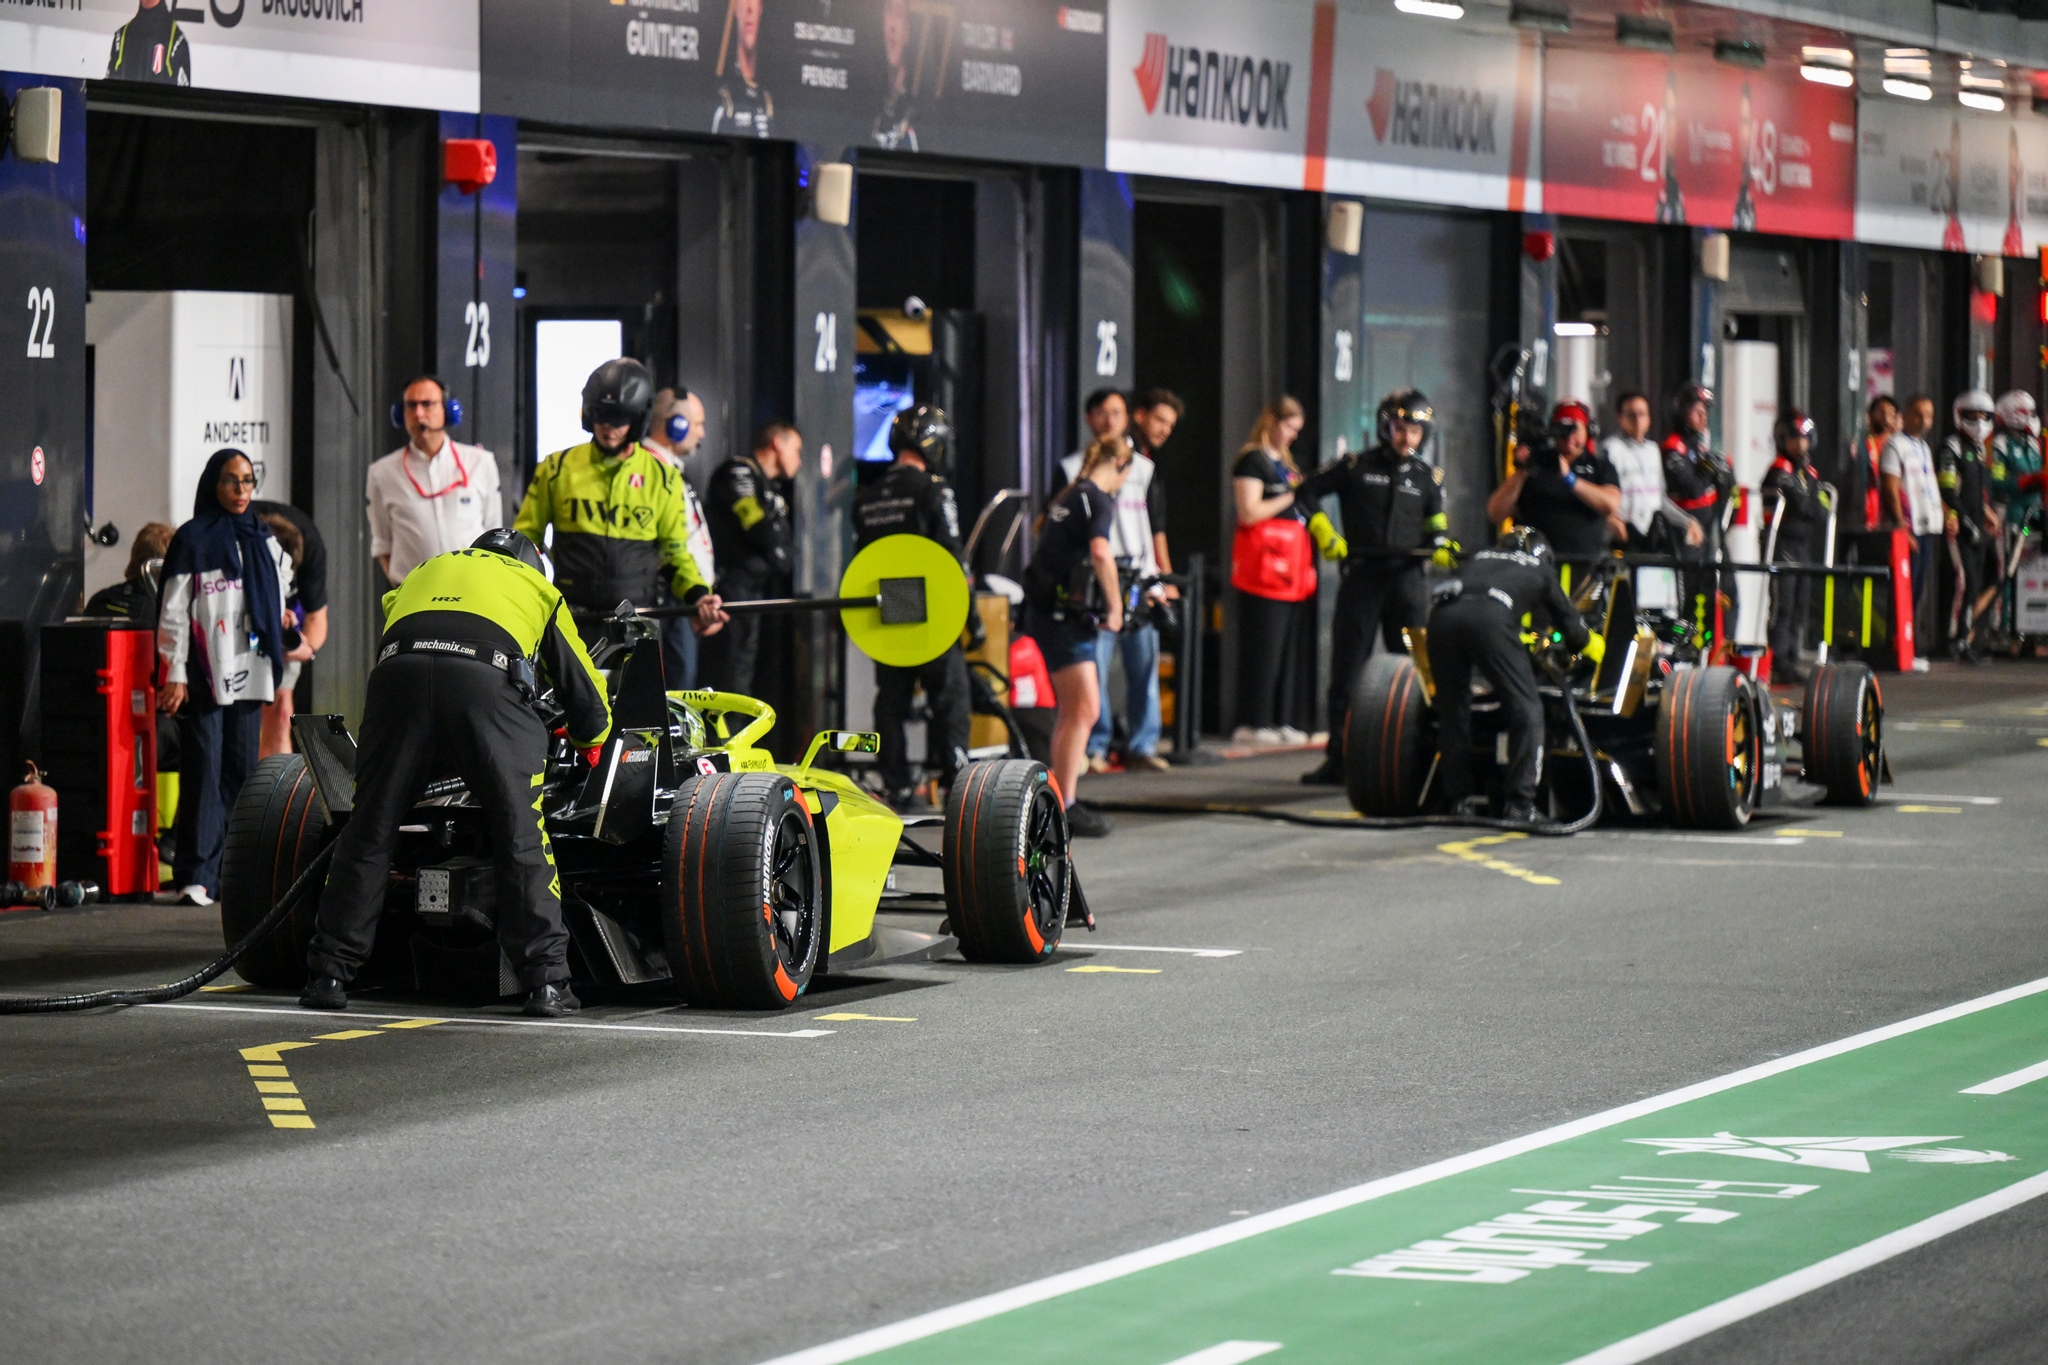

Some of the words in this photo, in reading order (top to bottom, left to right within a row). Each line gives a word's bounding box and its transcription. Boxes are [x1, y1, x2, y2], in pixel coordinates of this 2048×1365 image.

[626, 10, 699, 61] GÜNTHER
[27, 286, 54, 359] 22
[465, 301, 490, 368] 23
[814, 311, 837, 373] 24
[1096, 319, 1118, 377] 25
[204, 420, 270, 444] ANDRETTI
[563, 498, 632, 528] TWG
[412, 639, 477, 656] mechanix.com
